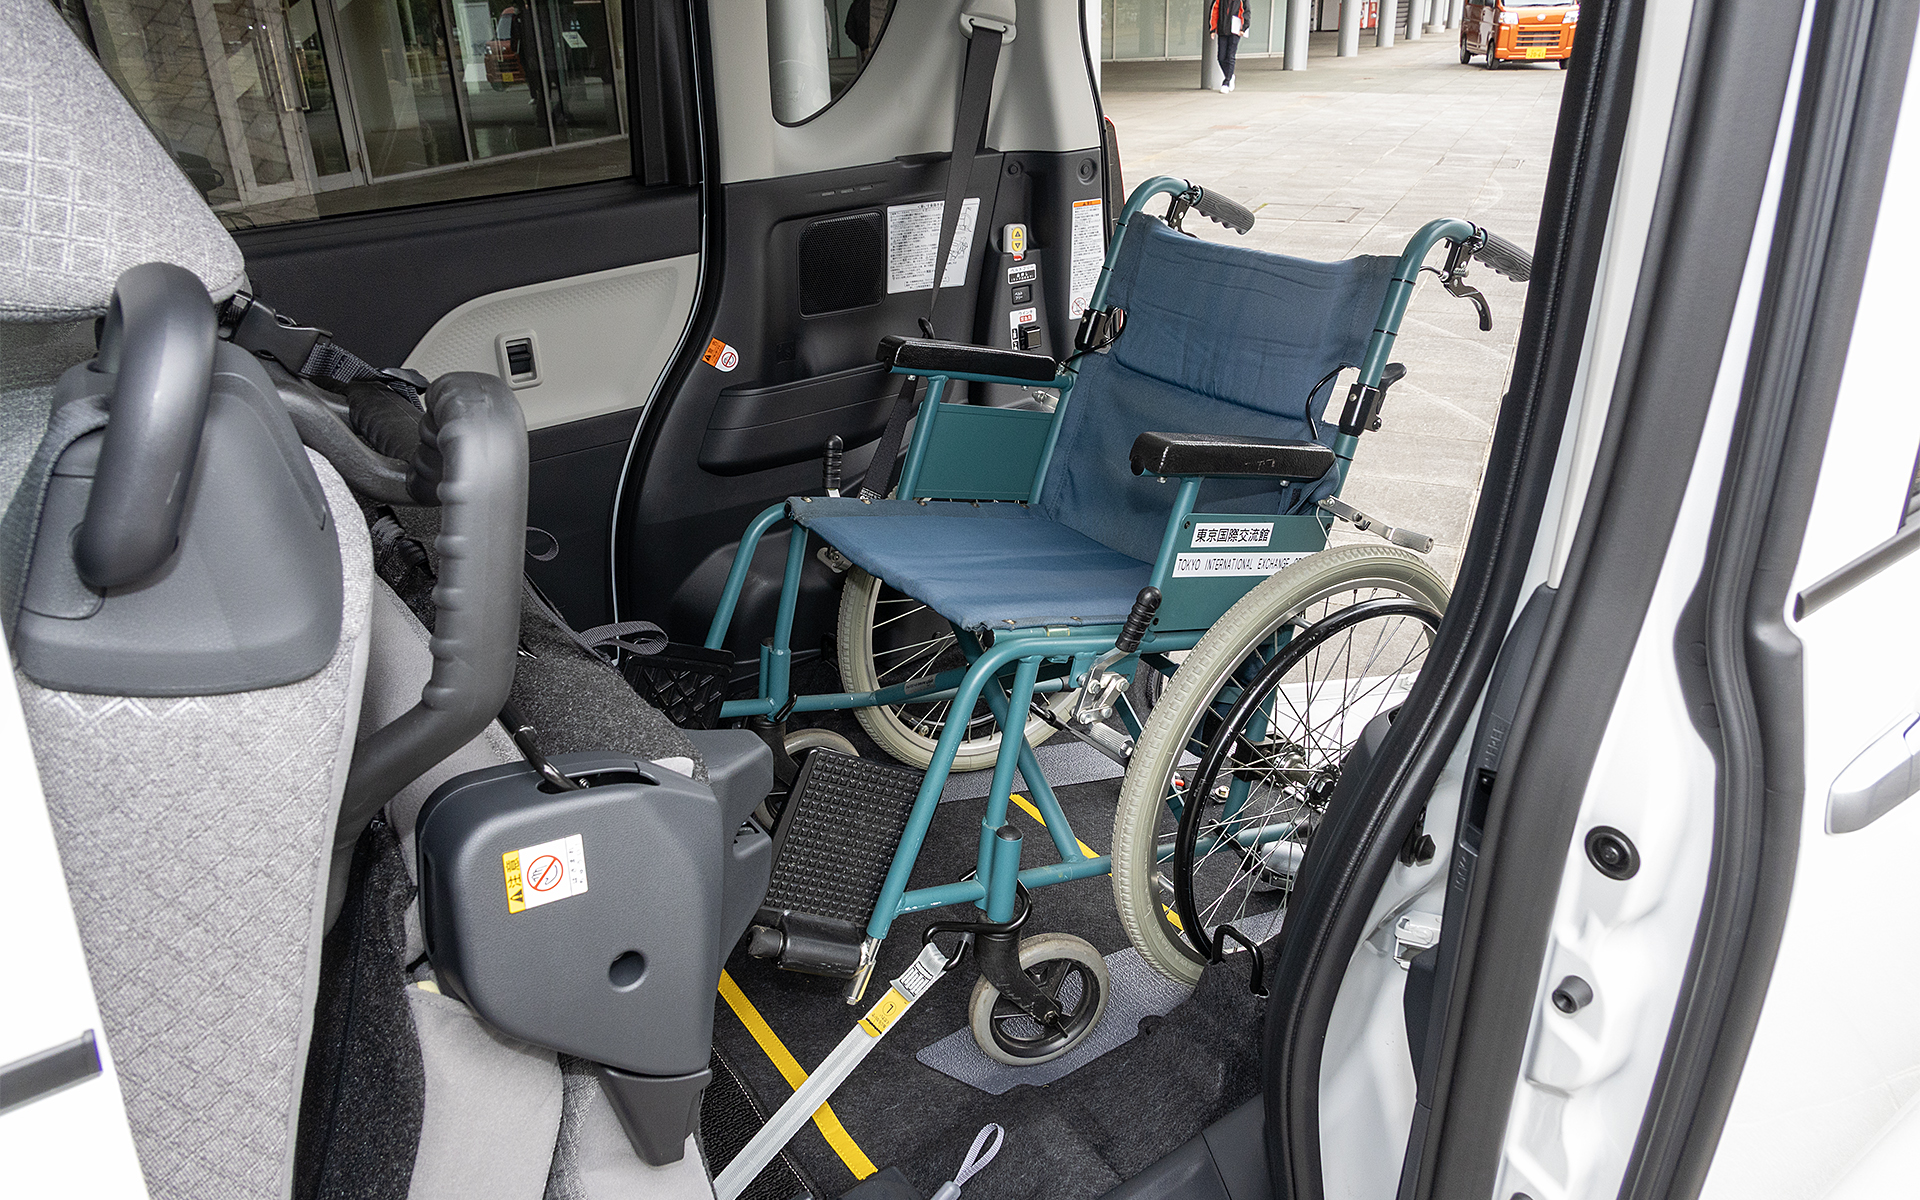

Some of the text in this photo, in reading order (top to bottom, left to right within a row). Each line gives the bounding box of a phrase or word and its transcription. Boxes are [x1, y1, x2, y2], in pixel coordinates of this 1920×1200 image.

[1194, 528, 1271, 543] 東京国際交流館
[1177, 558, 1201, 571] TOKYO
[1204, 558, 1253, 571] INTERNATIONAL
[1257, 557, 1290, 570] EXCHANGE
[505, 857, 522, 889] 注意
